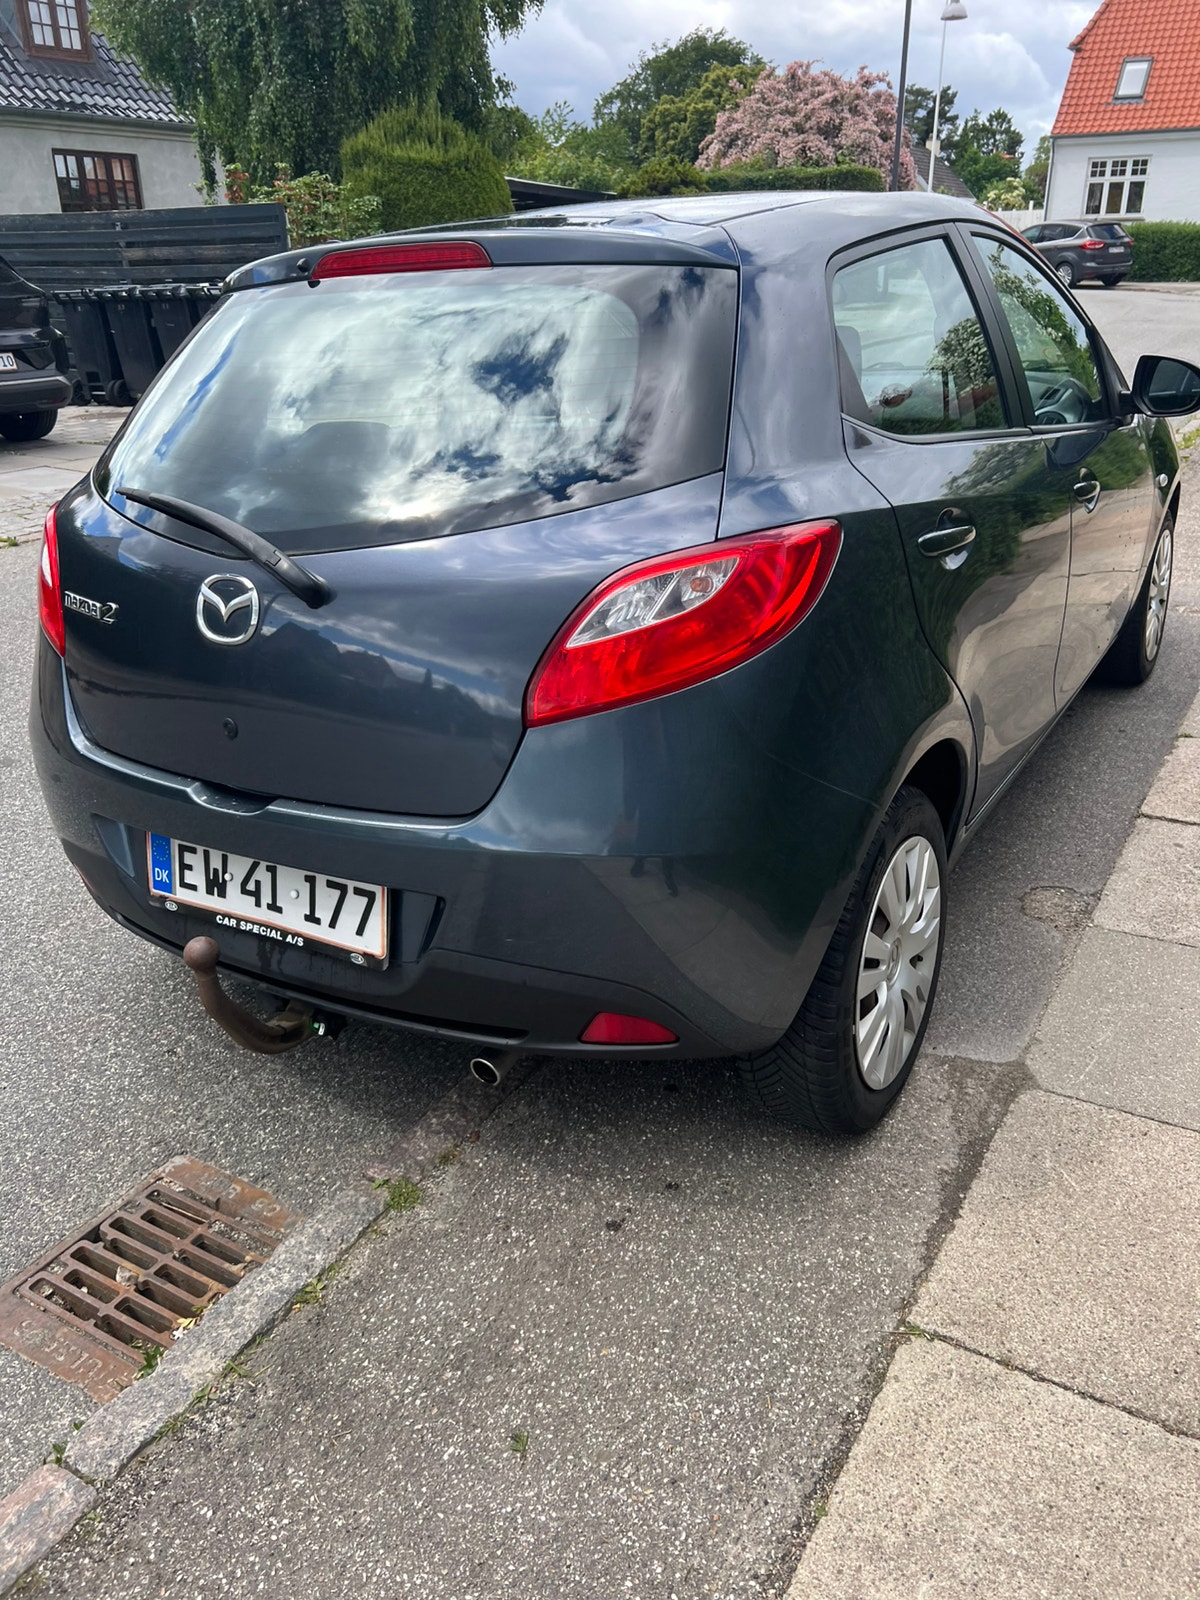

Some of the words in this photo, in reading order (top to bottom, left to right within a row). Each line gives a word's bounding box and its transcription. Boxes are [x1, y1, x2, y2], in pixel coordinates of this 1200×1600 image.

[154, 867, 170, 883] DK
[178, 843, 229, 899] EW
[240, 861, 283, 914] 41
[304, 874, 377, 937] 177
[216, 914, 237, 928] CAR
[239, 920, 283, 941] SPECIAL
[285, 934, 304, 947] A/S
